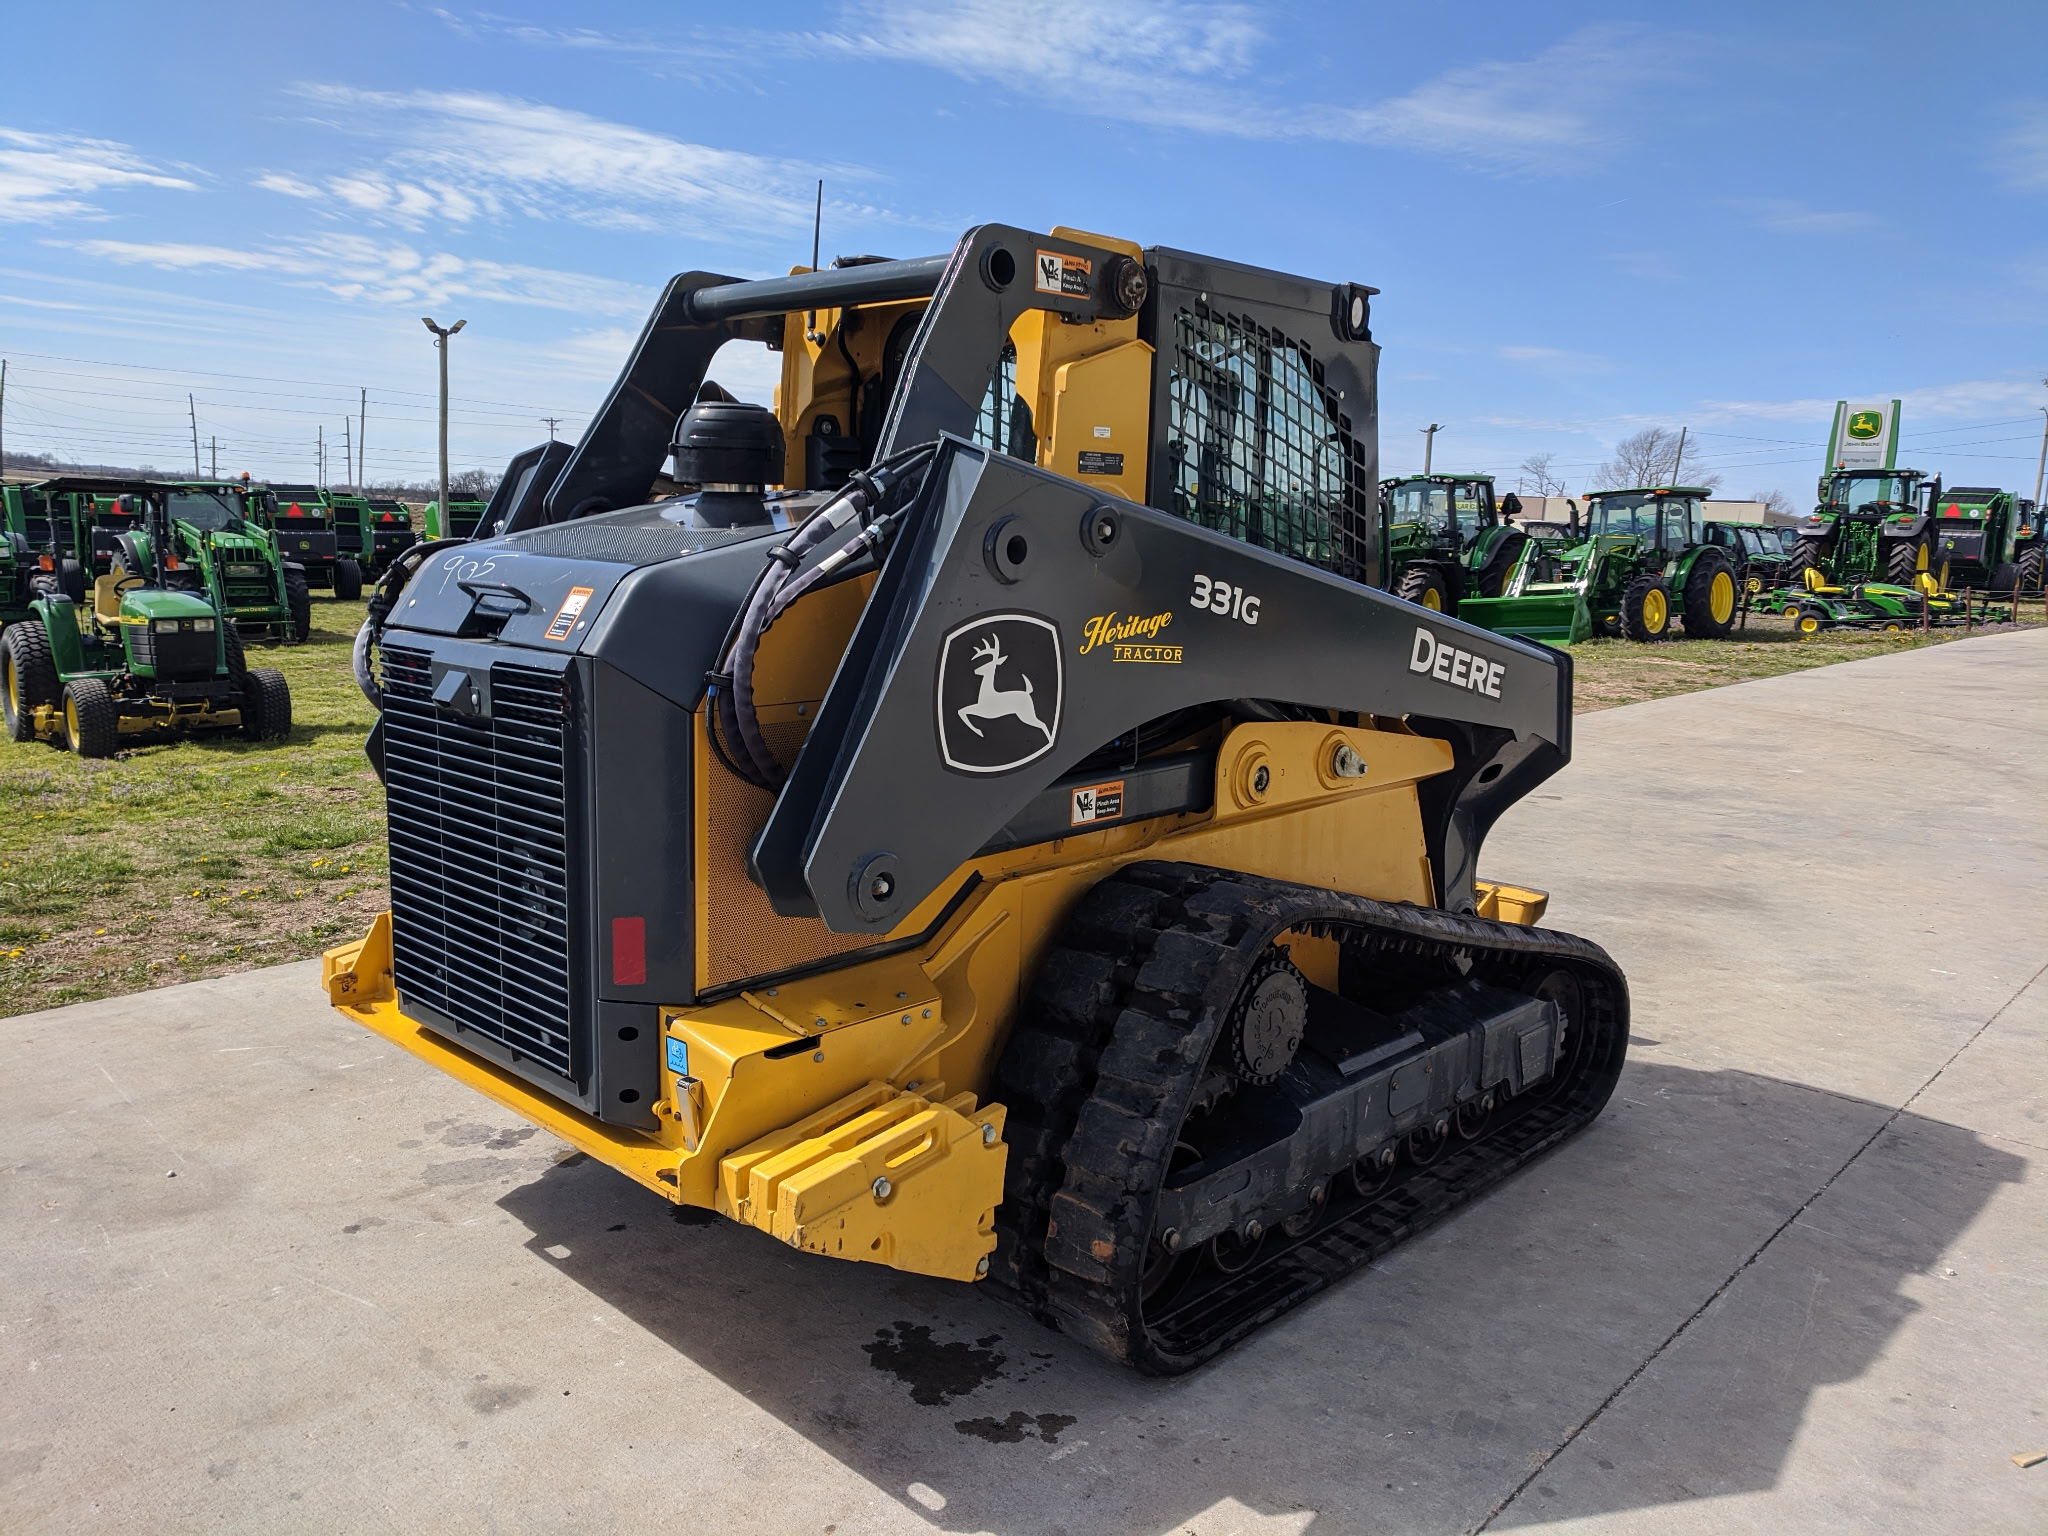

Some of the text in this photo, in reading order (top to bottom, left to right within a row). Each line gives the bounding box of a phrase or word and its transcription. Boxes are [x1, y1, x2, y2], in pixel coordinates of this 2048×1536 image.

[1190, 574, 1261, 625] 331G
[1079, 610, 1173, 655] Heritage
[1113, 647, 1183, 661] TRACTOR
[1409, 627, 1506, 698] DEERE
